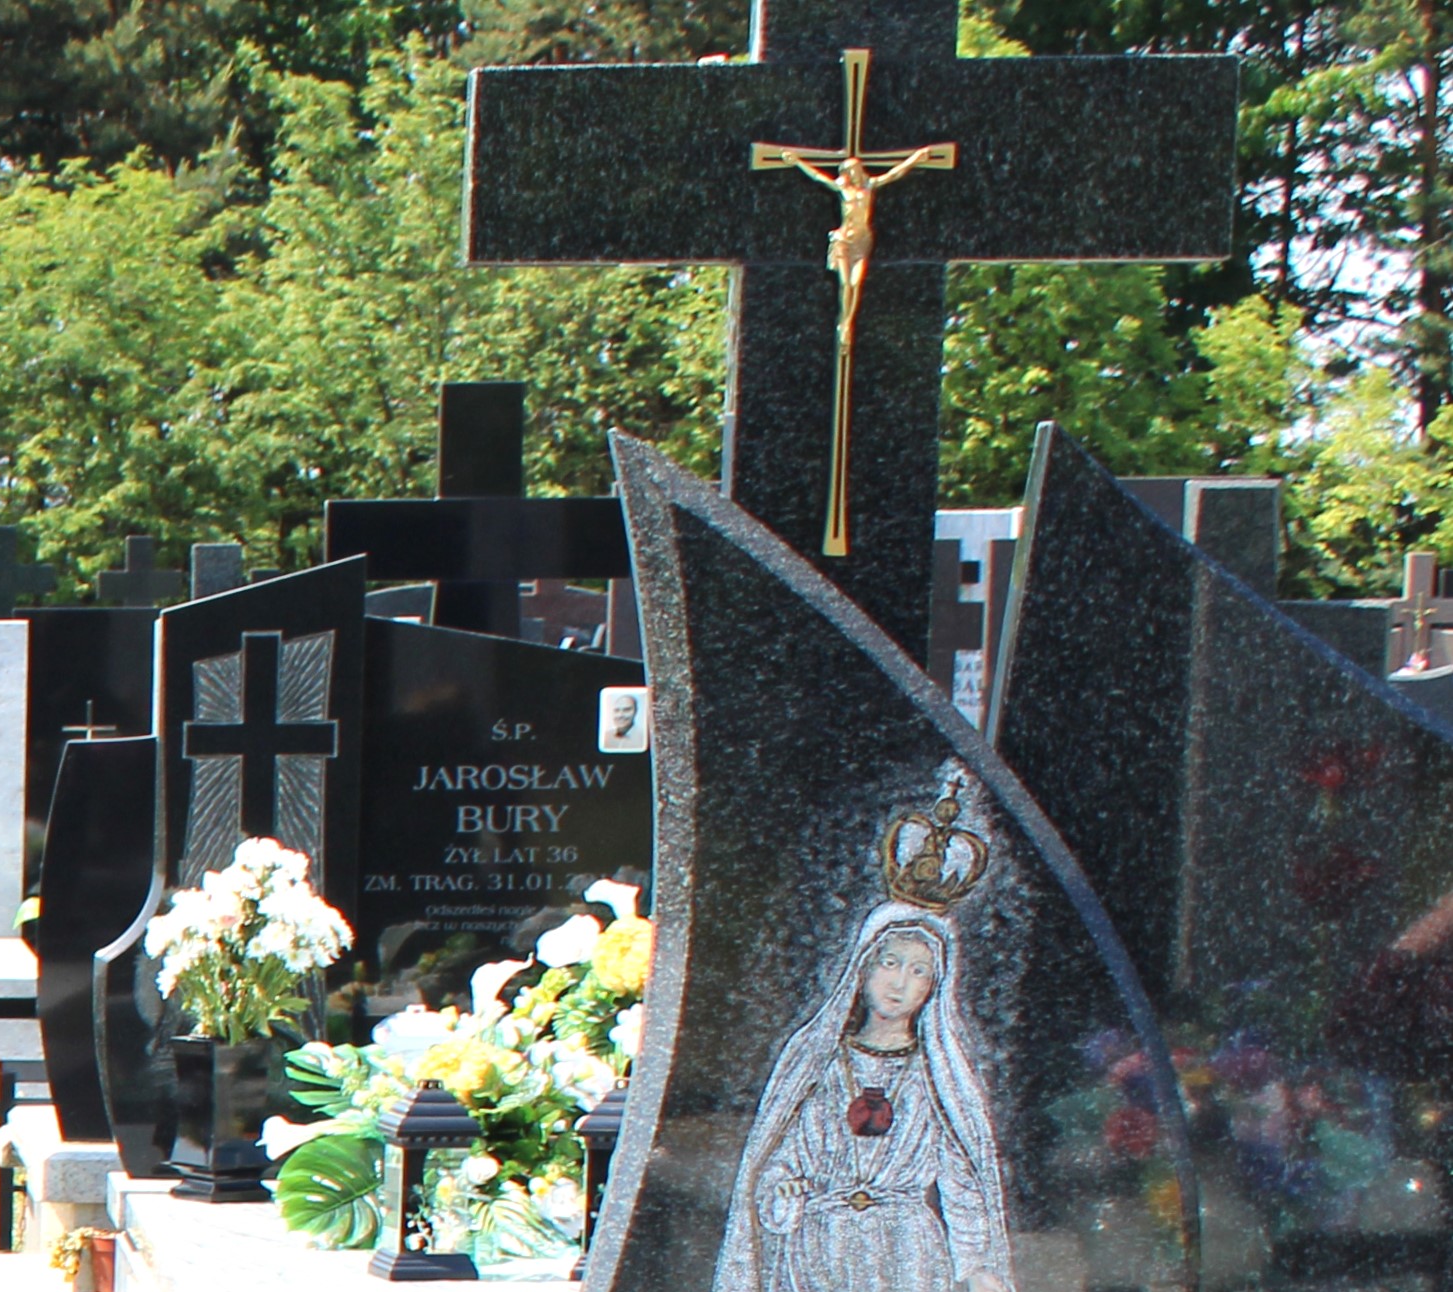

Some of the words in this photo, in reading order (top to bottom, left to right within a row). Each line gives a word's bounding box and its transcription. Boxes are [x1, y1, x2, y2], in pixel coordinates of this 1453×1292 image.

[491, 718, 537, 741] Ś.P.
[413, 764, 614, 791] JAROSŁAW
[456, 804, 569, 833] BURY
[444, 843, 488, 864] ŻYŁ
[493, 847, 540, 864] LAT
[546, 846, 578, 863] 36
[364, 874, 402, 891] ZM.
[410, 874, 479, 891] TRAG.
